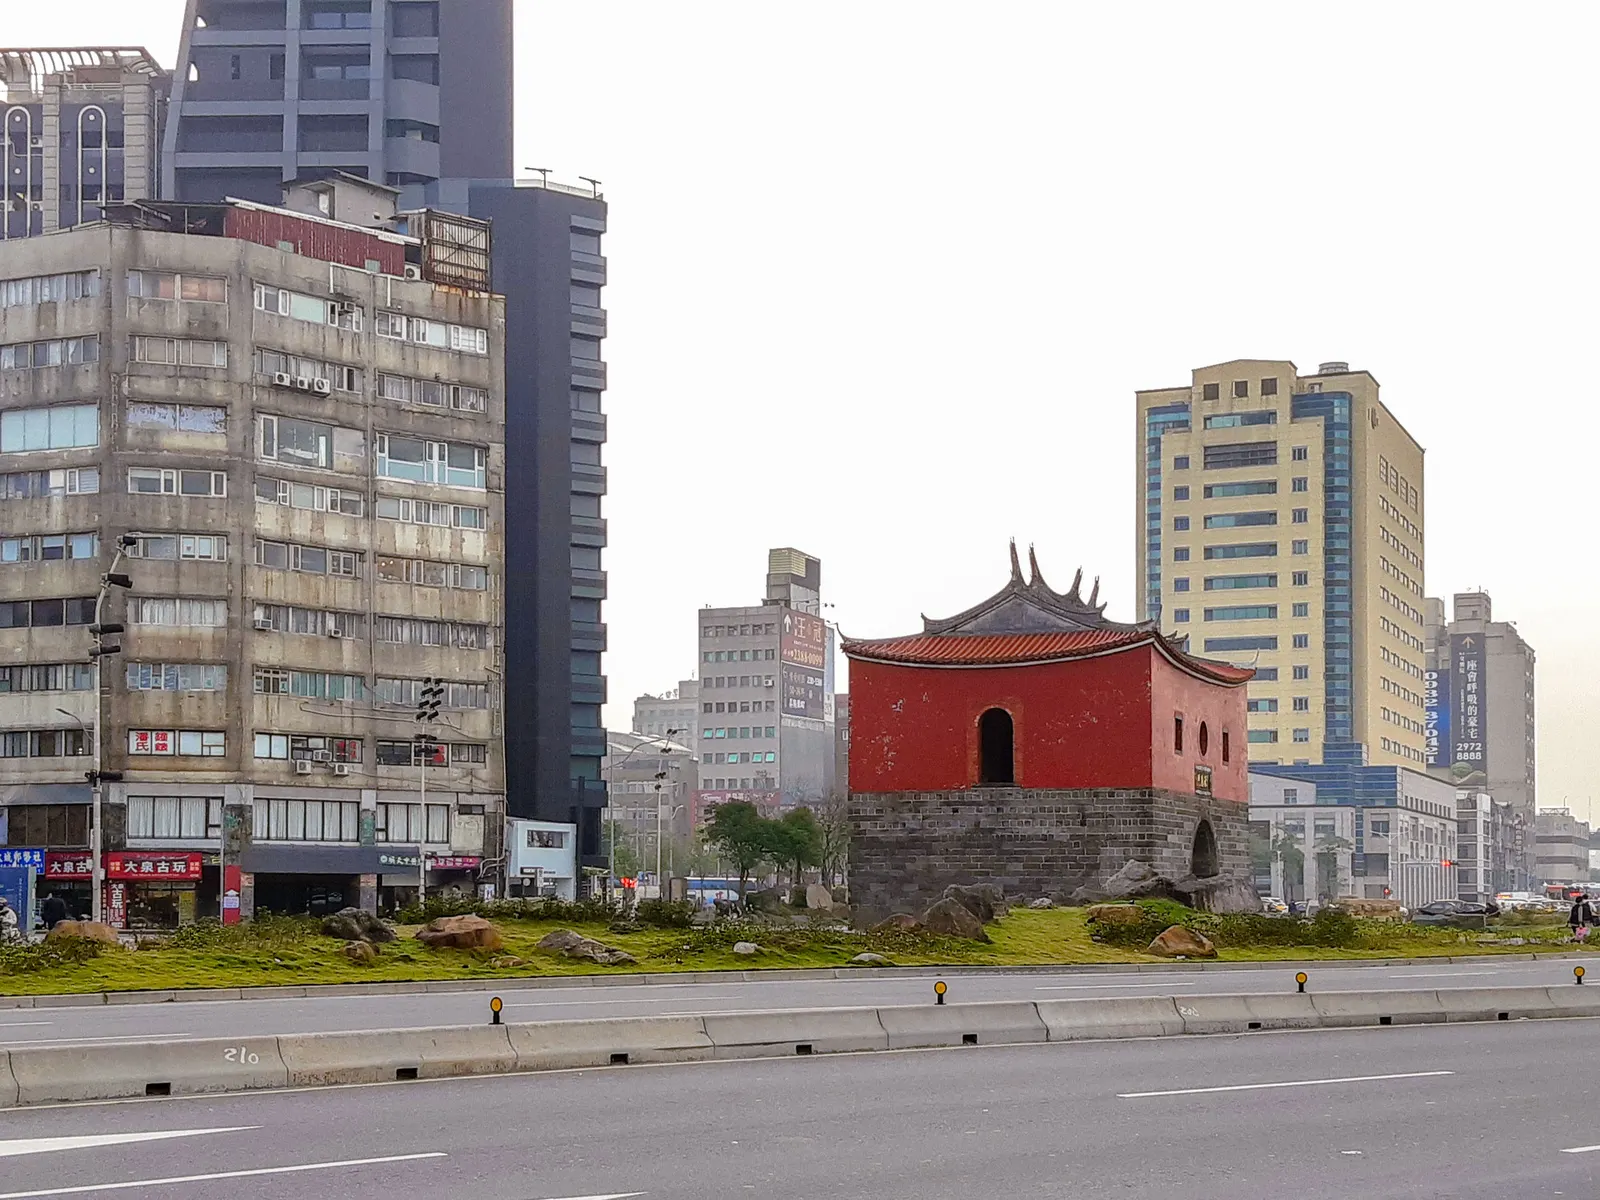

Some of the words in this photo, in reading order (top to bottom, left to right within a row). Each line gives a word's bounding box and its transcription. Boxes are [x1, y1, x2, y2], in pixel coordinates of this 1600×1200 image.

[1425, 671, 1438, 707] 0932
[1466, 651, 1478, 739] 一座會呼吸的豪宅
[1456, 742, 1482, 751] 2972
[1456, 752, 1482, 760] 8888
[50, 861, 93, 873] 大泉古
[124, 861, 187, 874] 大泉古玩
[223, 1047, 259, 1065] 210
